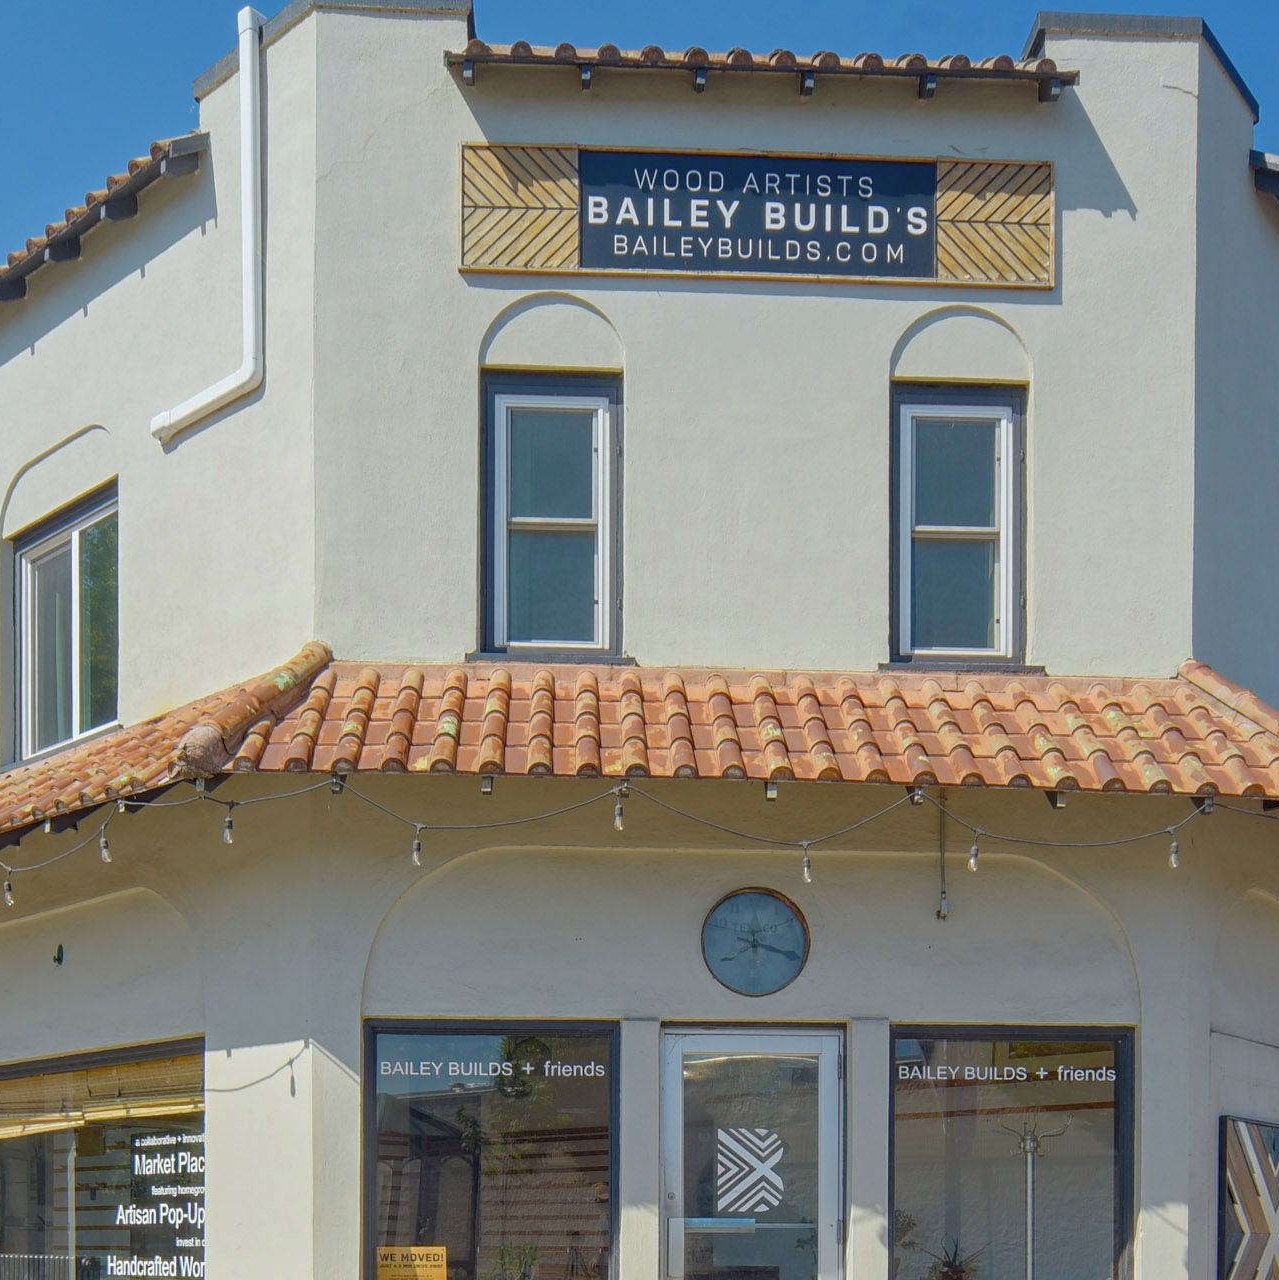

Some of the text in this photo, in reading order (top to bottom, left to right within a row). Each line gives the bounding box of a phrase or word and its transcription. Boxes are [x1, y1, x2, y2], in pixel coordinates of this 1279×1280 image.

[634, 168, 874, 199] WOOD ARTISTS
[587, 195, 928, 235] BAILEY BUILD'S
[613, 234, 904, 264] BAILEYBUILDS.COM
[380, 1061, 605, 1077] BAILEY BUILDS + friends
[898, 1065, 1116, 1081] BAILEY BUILDS + friends
[134, 1153, 176, 1176] Market
[151, 1185, 177, 1197] featuring
[115, 1203, 157, 1225] Artisan
[176, 1237, 194, 1247] invest
[194, 1237, 201, 1247] in
[107, 1254, 177, 1277] Handcrafted
[379, 1253, 444, 1262] WE MOVED!
